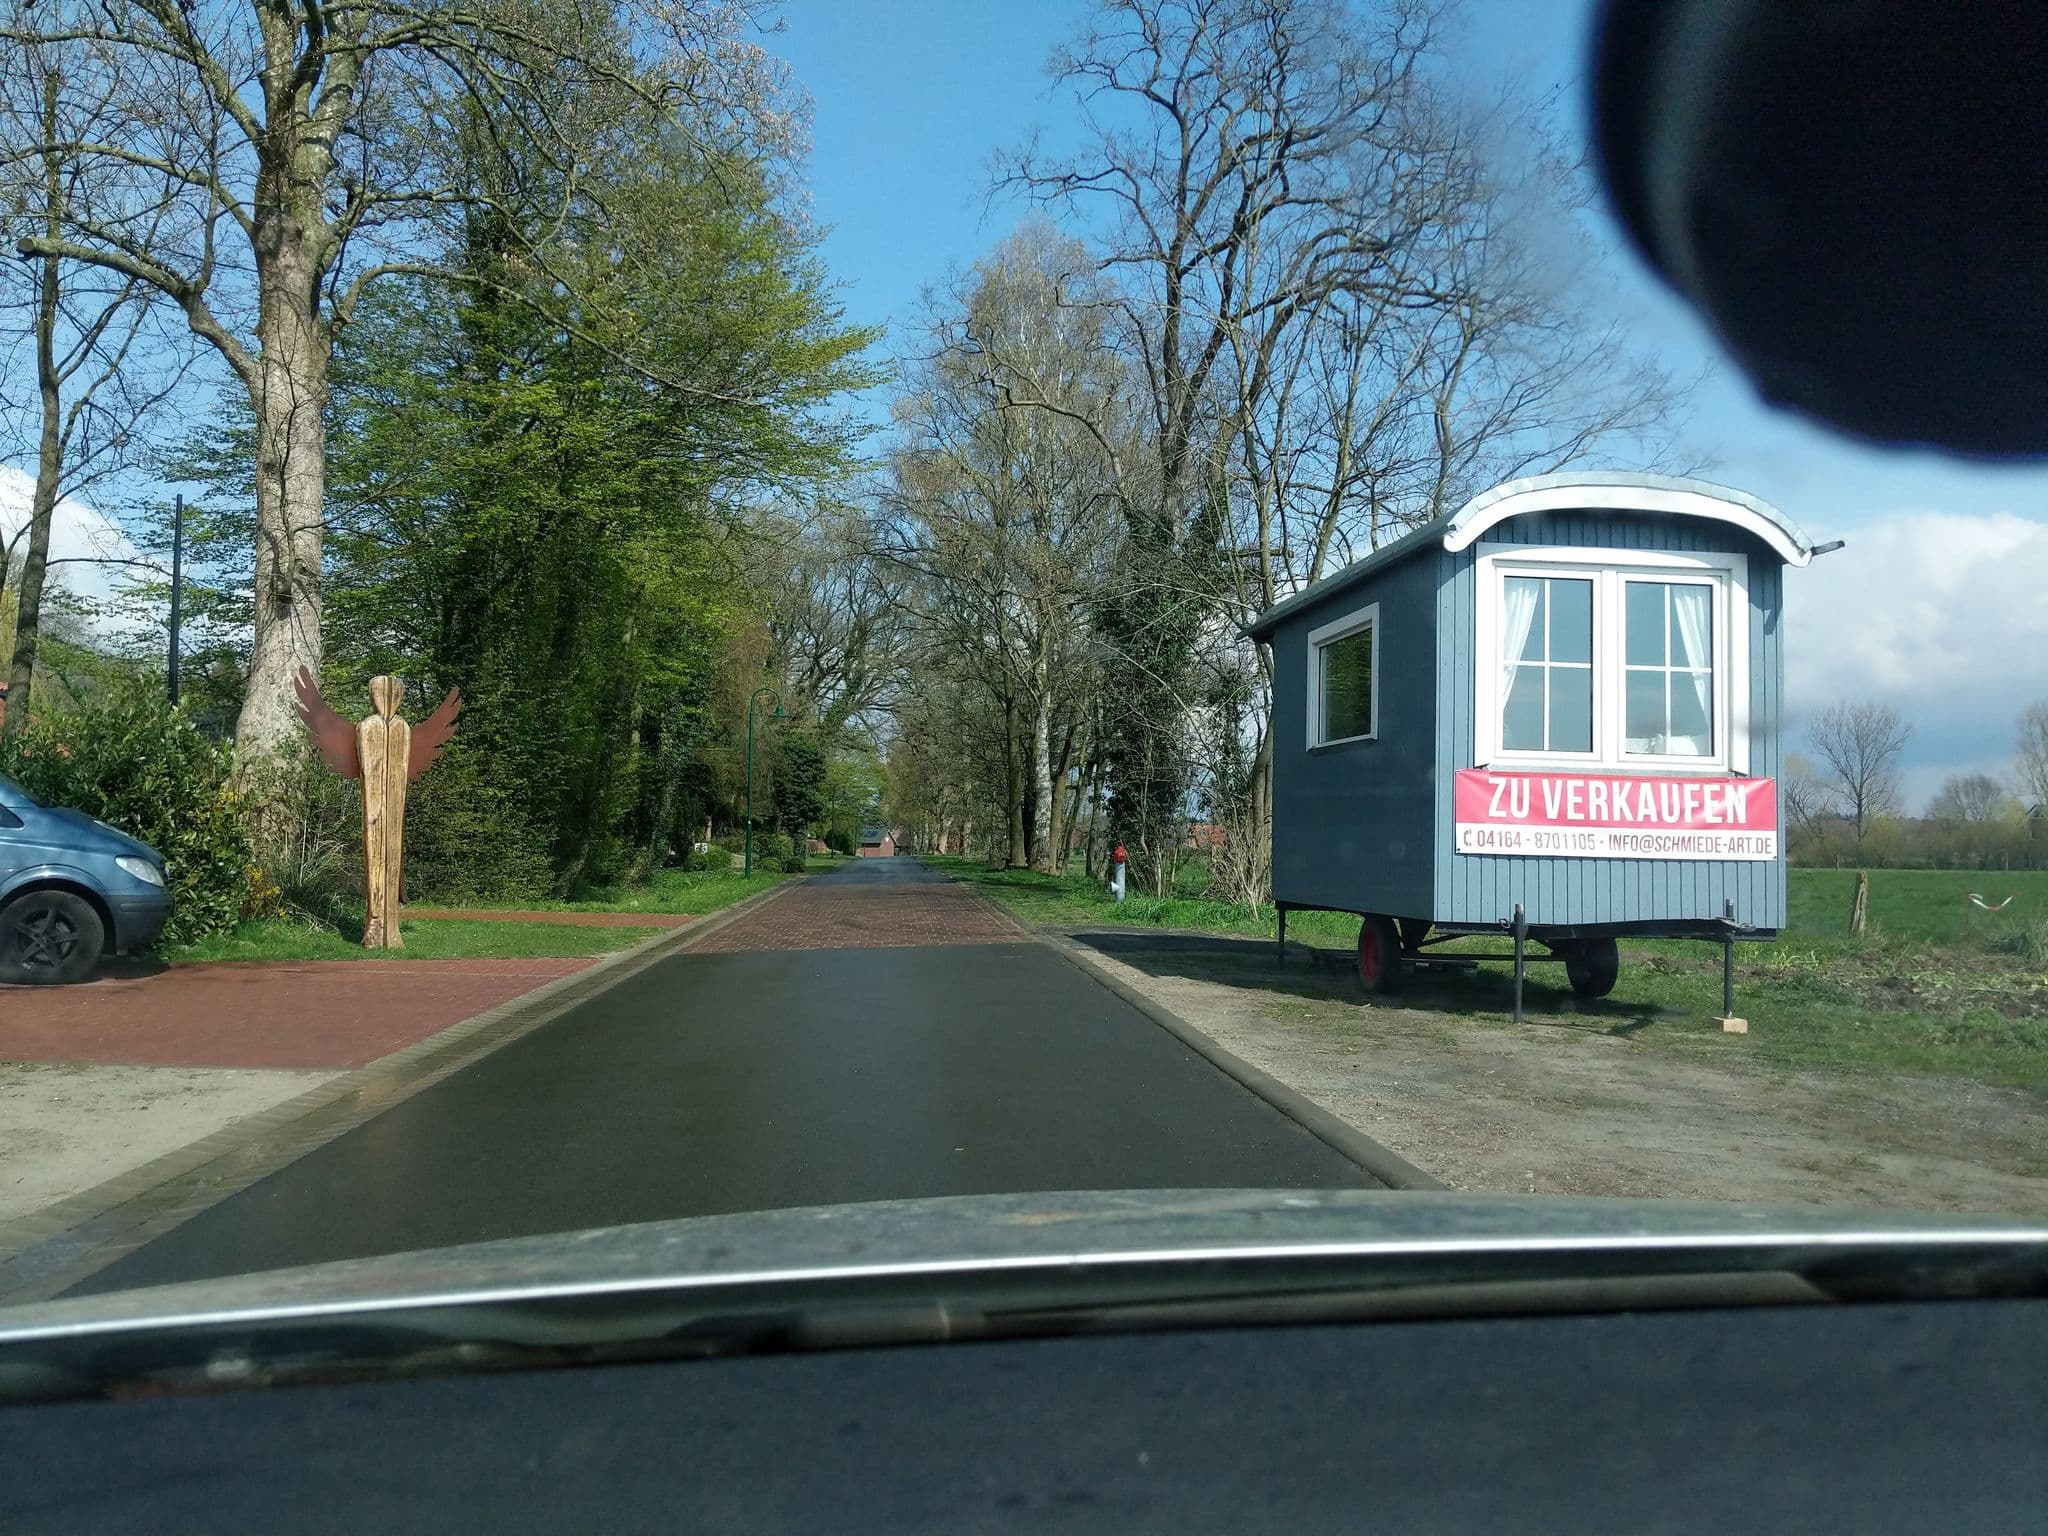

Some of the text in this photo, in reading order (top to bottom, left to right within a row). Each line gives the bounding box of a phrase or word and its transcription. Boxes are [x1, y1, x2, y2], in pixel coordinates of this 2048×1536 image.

[1488, 776, 1747, 824] ZU VERKAUFEN
[1477, 830, 1522, 848] 04164
[1534, 832, 1596, 850] 8701105
[1608, 833, 1773, 855] INFO@SCHMIEDE-ART.DE
